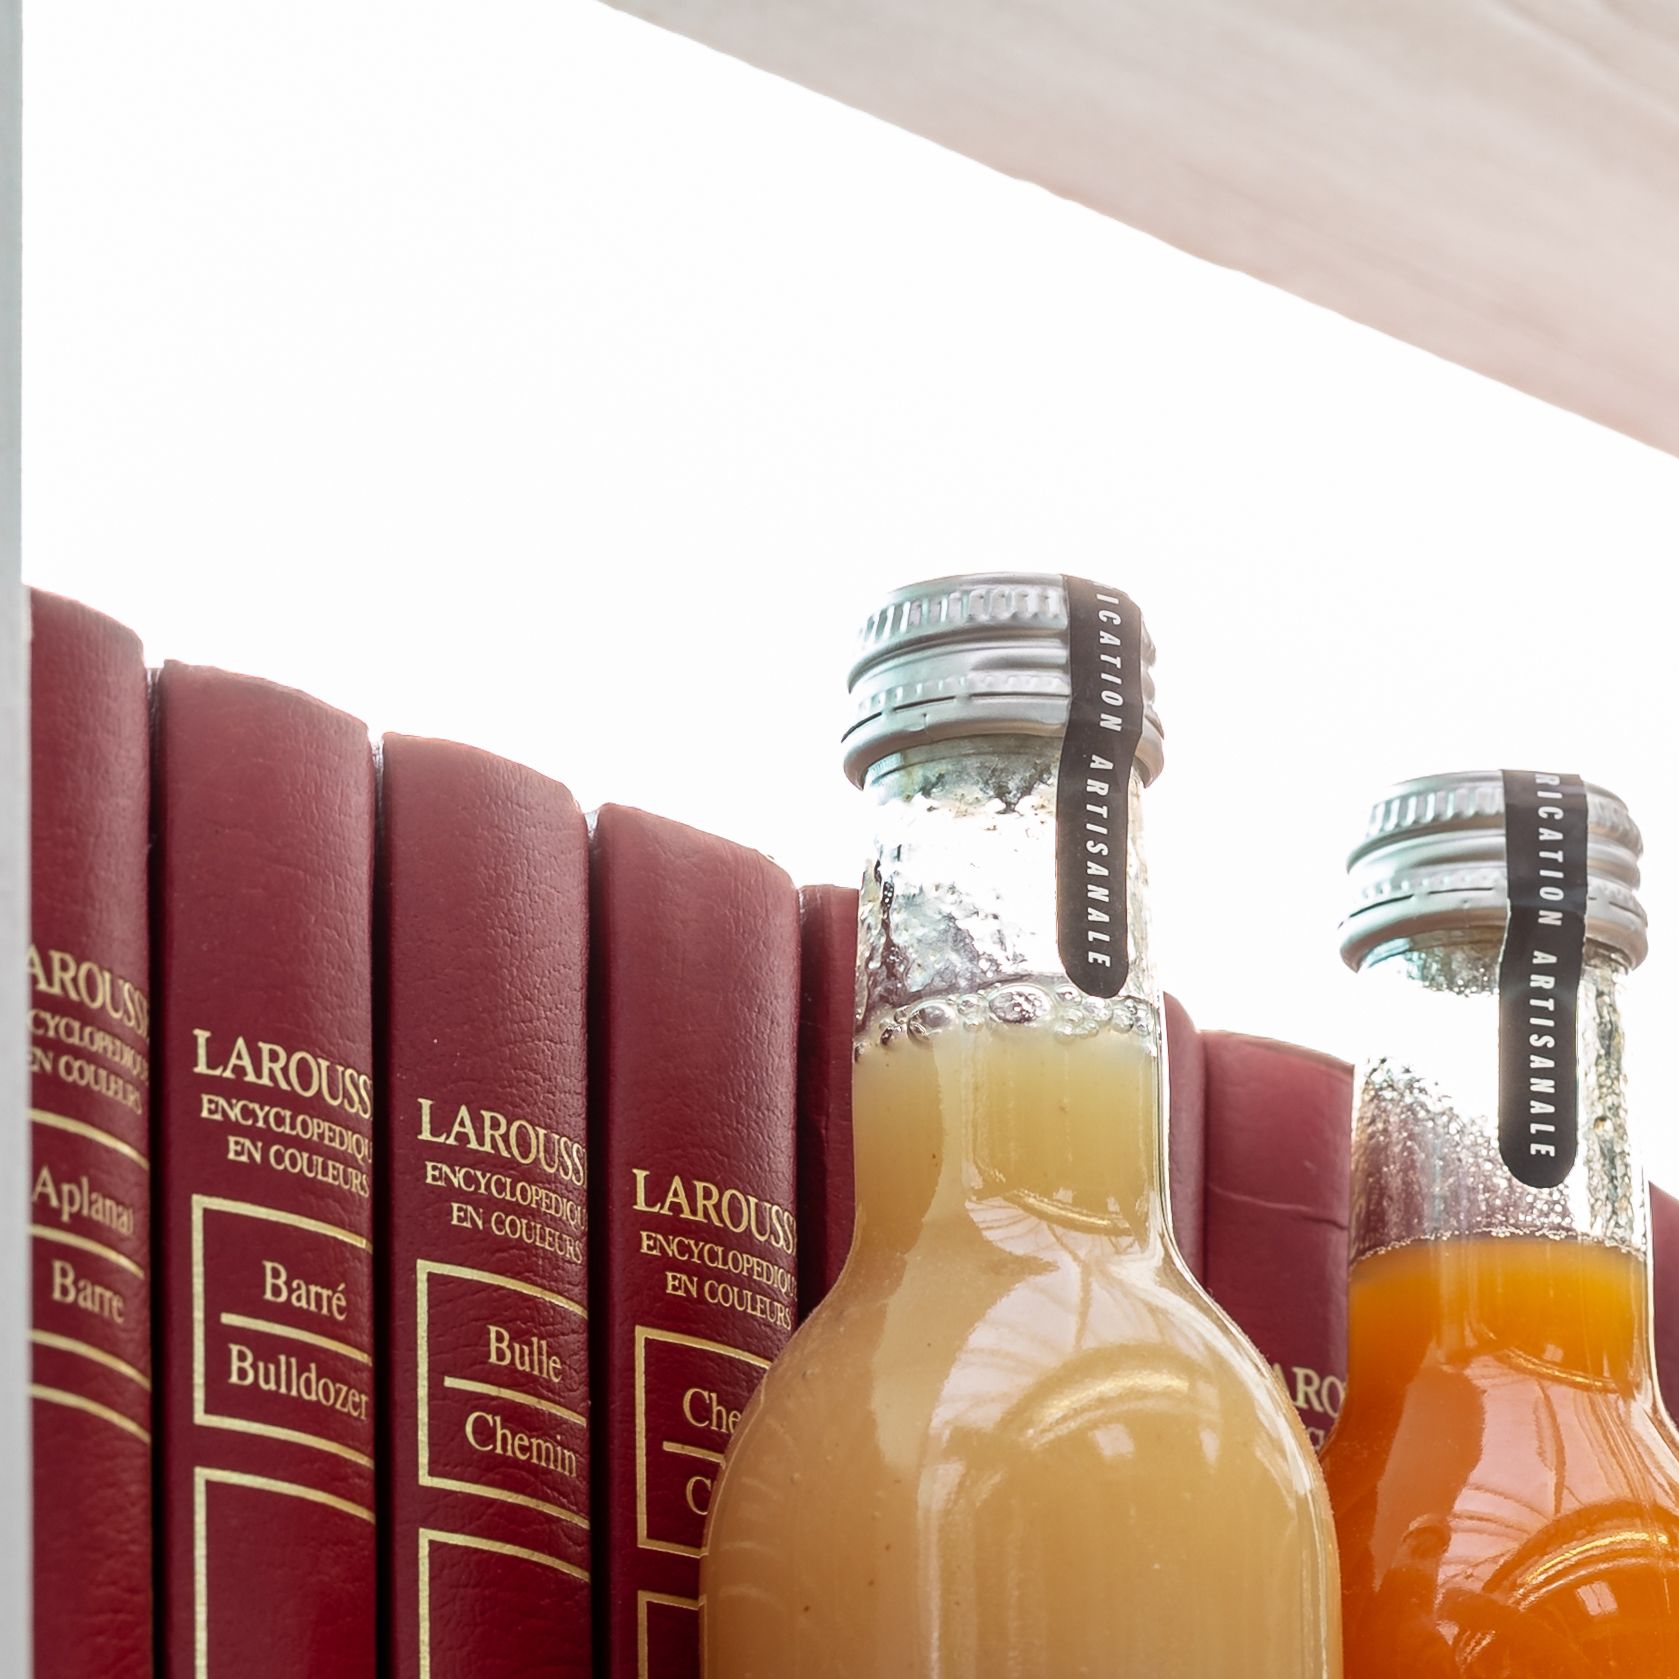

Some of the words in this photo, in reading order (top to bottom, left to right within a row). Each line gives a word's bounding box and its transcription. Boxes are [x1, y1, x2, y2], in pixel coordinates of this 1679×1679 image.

[1095, 592, 1123, 733] ICATION
[1086, 753, 1114, 969] ARTISANALE
[192, 1028, 373, 1120] LAROUSS
[1529, 950, 1557, 1159] ARTISANALE
[227, 1135, 262, 1164] EN
[269, 1144, 369, 1198] COULEURS
[417, 1098, 587, 1188] LAROUSS
[425, 1161, 588, 1231] ENCYCLOPEDIQU
[632, 1168, 797, 1256] LAROUSS
[451, 1202, 483, 1230] EN
[491, 1211, 583, 1264] COULEURS
[640, 1230, 798, 1301] ENCYCLOPEDIQU
[261, 1260, 347, 1322] Barré
[665, 1271, 698, 1298] EN
[704, 1280, 792, 1331] COULEURS
[228, 1343, 370, 1421] Bulldozer
[486, 1324, 562, 1383] Bulle
[465, 1411, 577, 1478] Chemin
